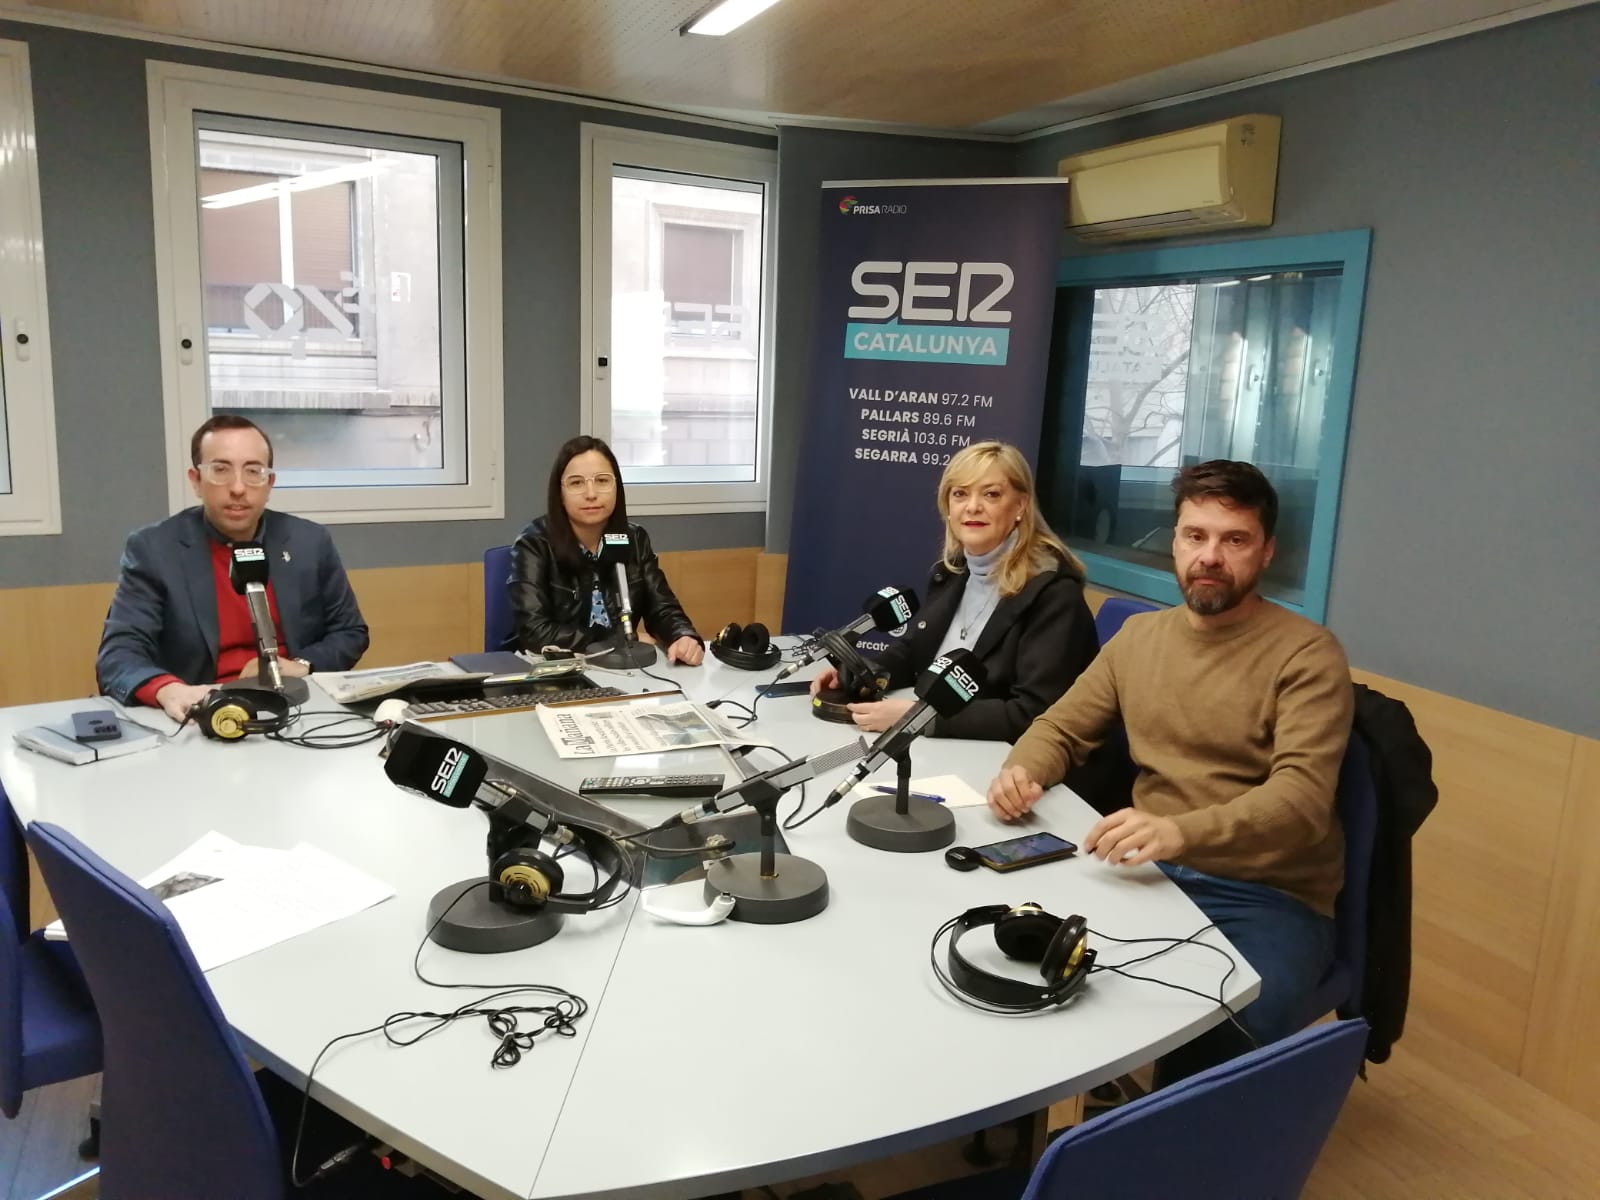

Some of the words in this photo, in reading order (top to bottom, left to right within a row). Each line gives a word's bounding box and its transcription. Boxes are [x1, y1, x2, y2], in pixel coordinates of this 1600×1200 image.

[853, 205, 881, 215] PRISA
[881, 204, 907, 215] RADIO
[848, 261, 1015, 323] SER
[853, 332, 997, 356] CATALUNYA
[849, 388, 881, 401] VALL
[942, 393, 969, 406] 97.2
[973, 395, 993, 408] FM
[861, 409, 919, 423] PALLARS
[923, 412, 952, 426] 89.6
[956, 415, 976, 427] FM
[862, 428, 910, 443] SEGRIÀ
[914, 431, 947, 446] 103.6
[951, 435, 970, 447] FM
[855, 448, 917, 464] SEGARRA
[922, 452, 950, 466] 99.2
[895, 595, 912, 621] SER
[856, 640, 889, 651] ercat
[950, 665, 979, 696] SER
[431, 747, 462, 794] SER
